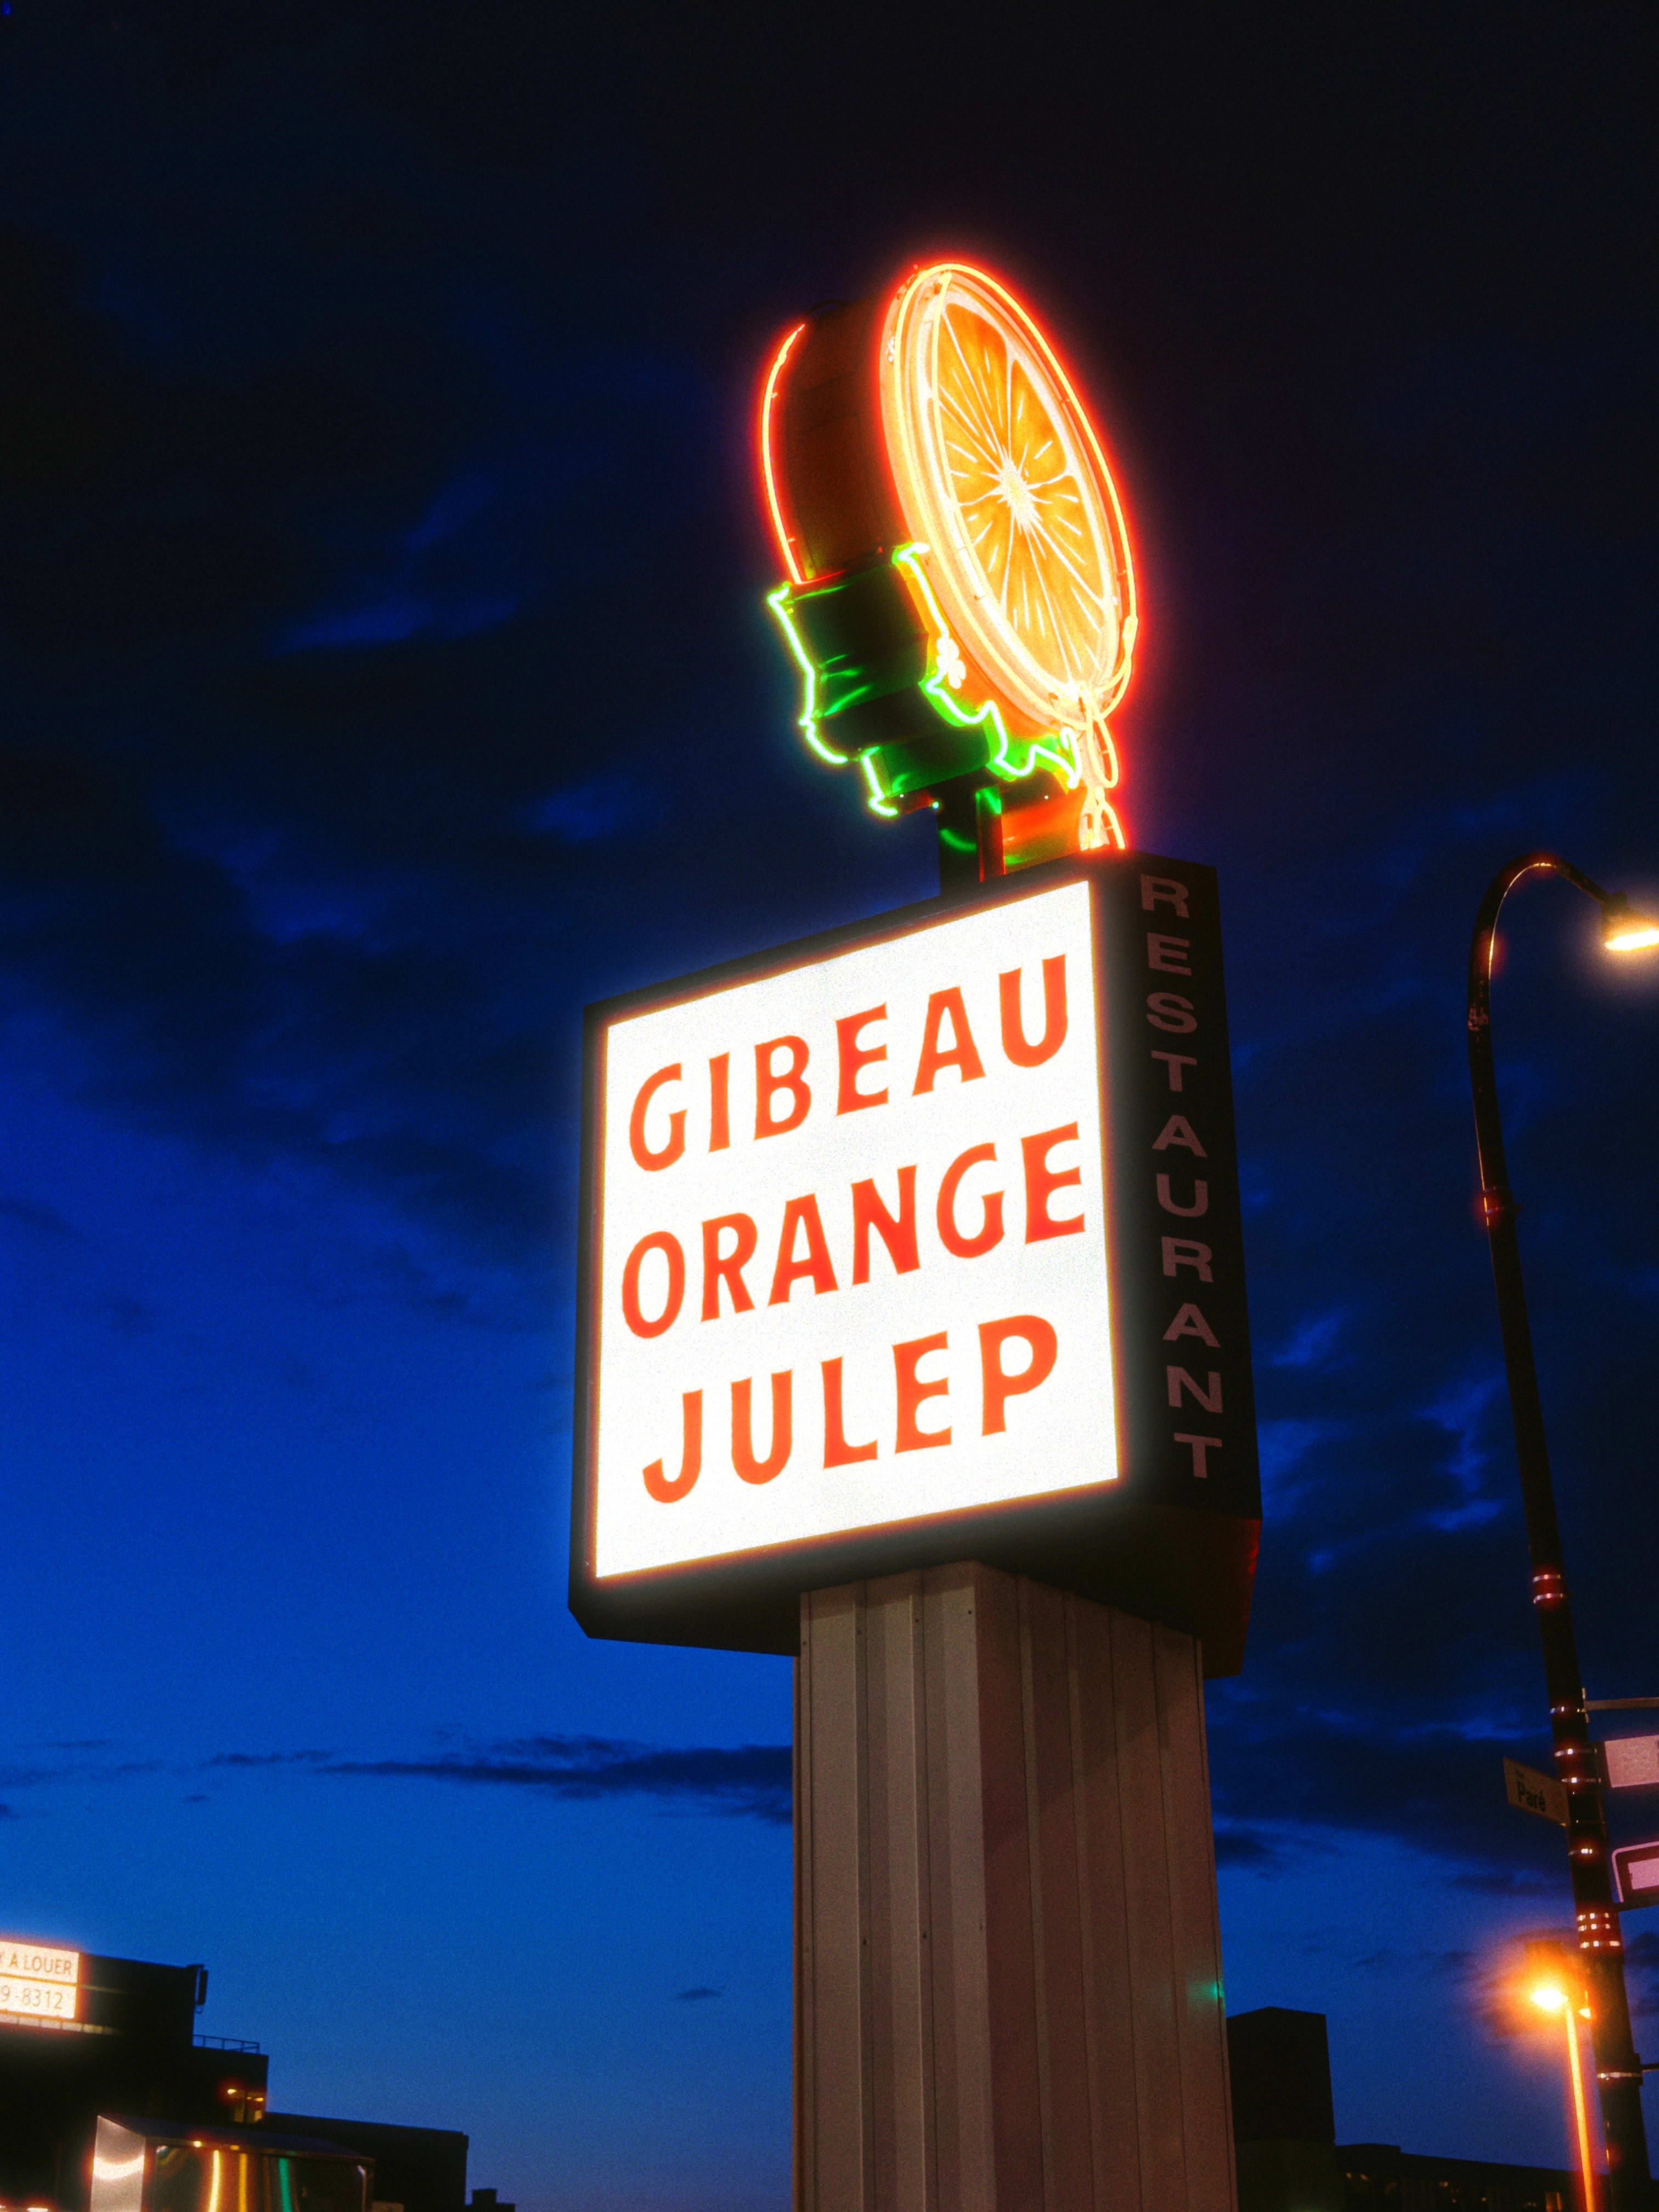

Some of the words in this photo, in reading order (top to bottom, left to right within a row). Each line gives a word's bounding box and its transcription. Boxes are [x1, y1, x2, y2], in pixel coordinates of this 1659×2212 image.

[629, 953, 1068, 1172] GIBEAU
[622, 1121, 1086, 1339] ORANGE
[1139, 873, 1223, 1480] RESTAURANT
[642, 1314, 1058, 1504] JULEP
[1517, 1780, 1546, 1813] Paré
[24, 1954, 71, 1976] LOUER
